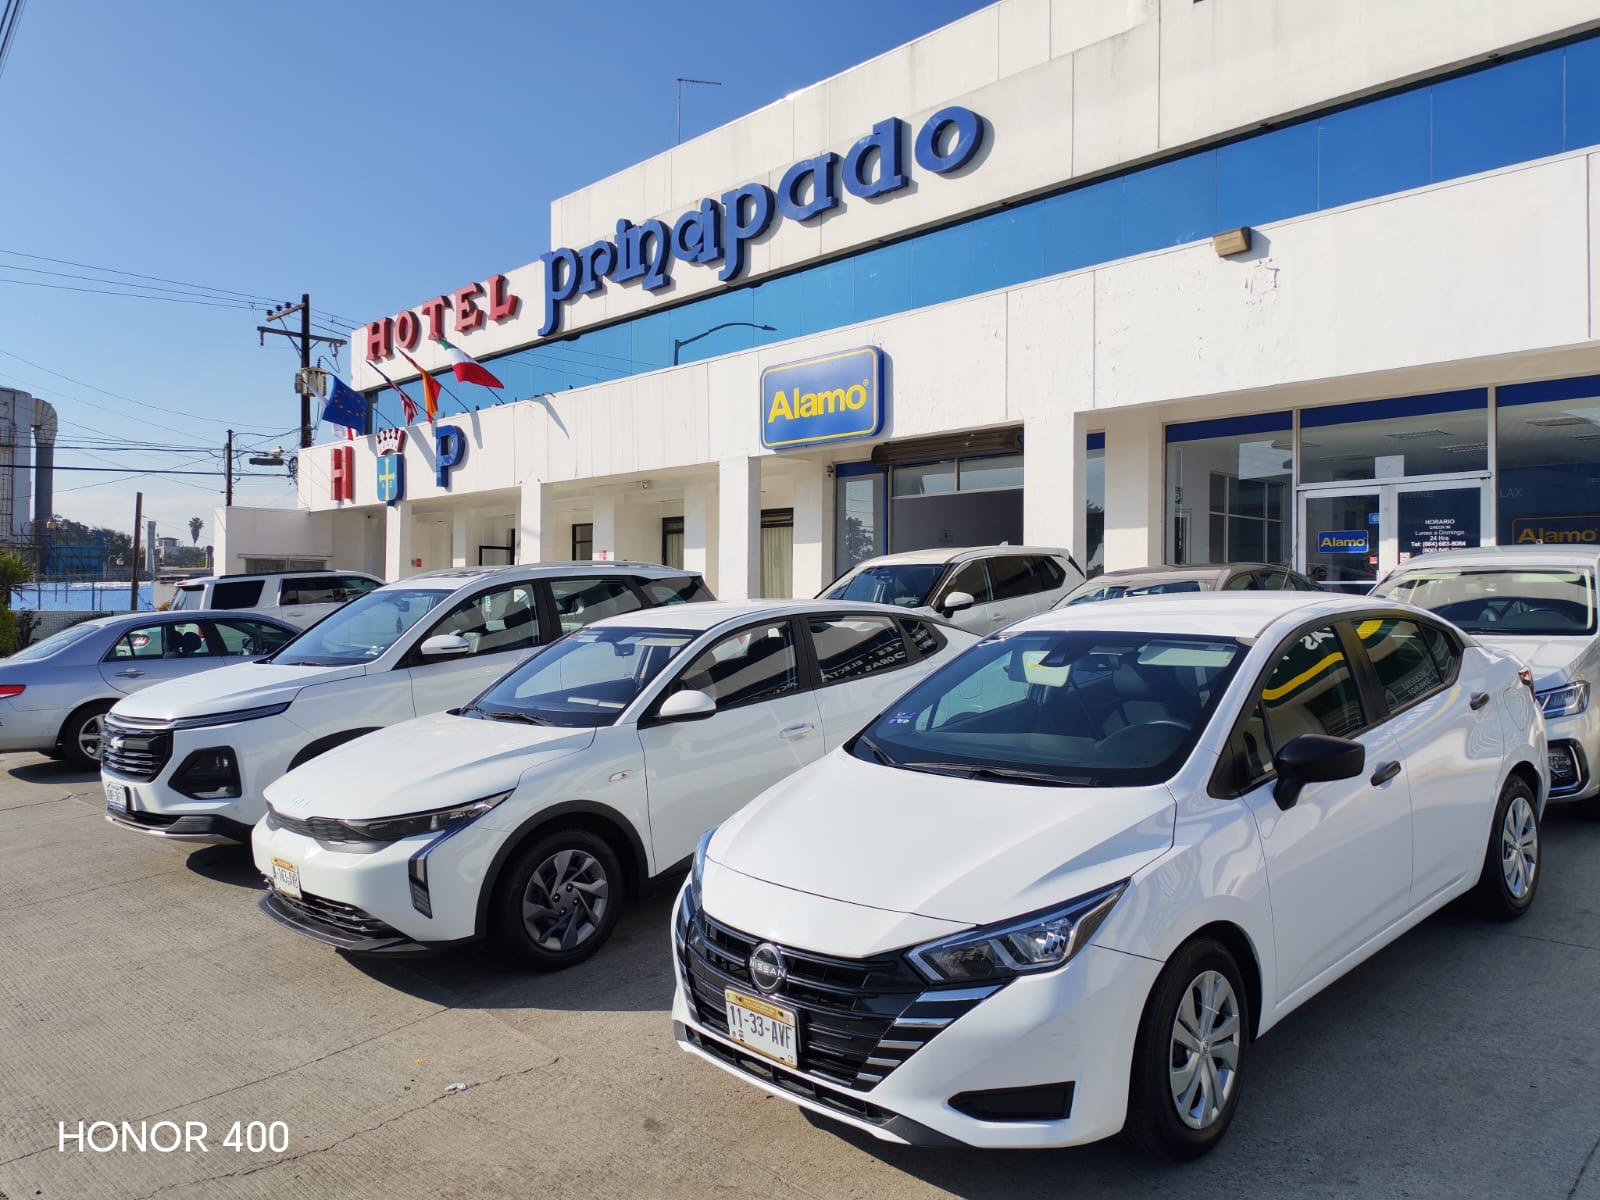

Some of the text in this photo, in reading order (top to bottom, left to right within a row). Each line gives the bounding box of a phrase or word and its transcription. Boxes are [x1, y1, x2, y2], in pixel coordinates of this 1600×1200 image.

[365, 274, 519, 362] HOTEL
[768, 384, 868, 424] Alamo
[331, 425, 465, 501] H P
[1320, 536, 1366, 548] Alamo
[1516, 527, 1598, 544] Alamo
[749, 956, 787, 979] NISSAN
[729, 1004, 793, 1050] 11-33-AVF
